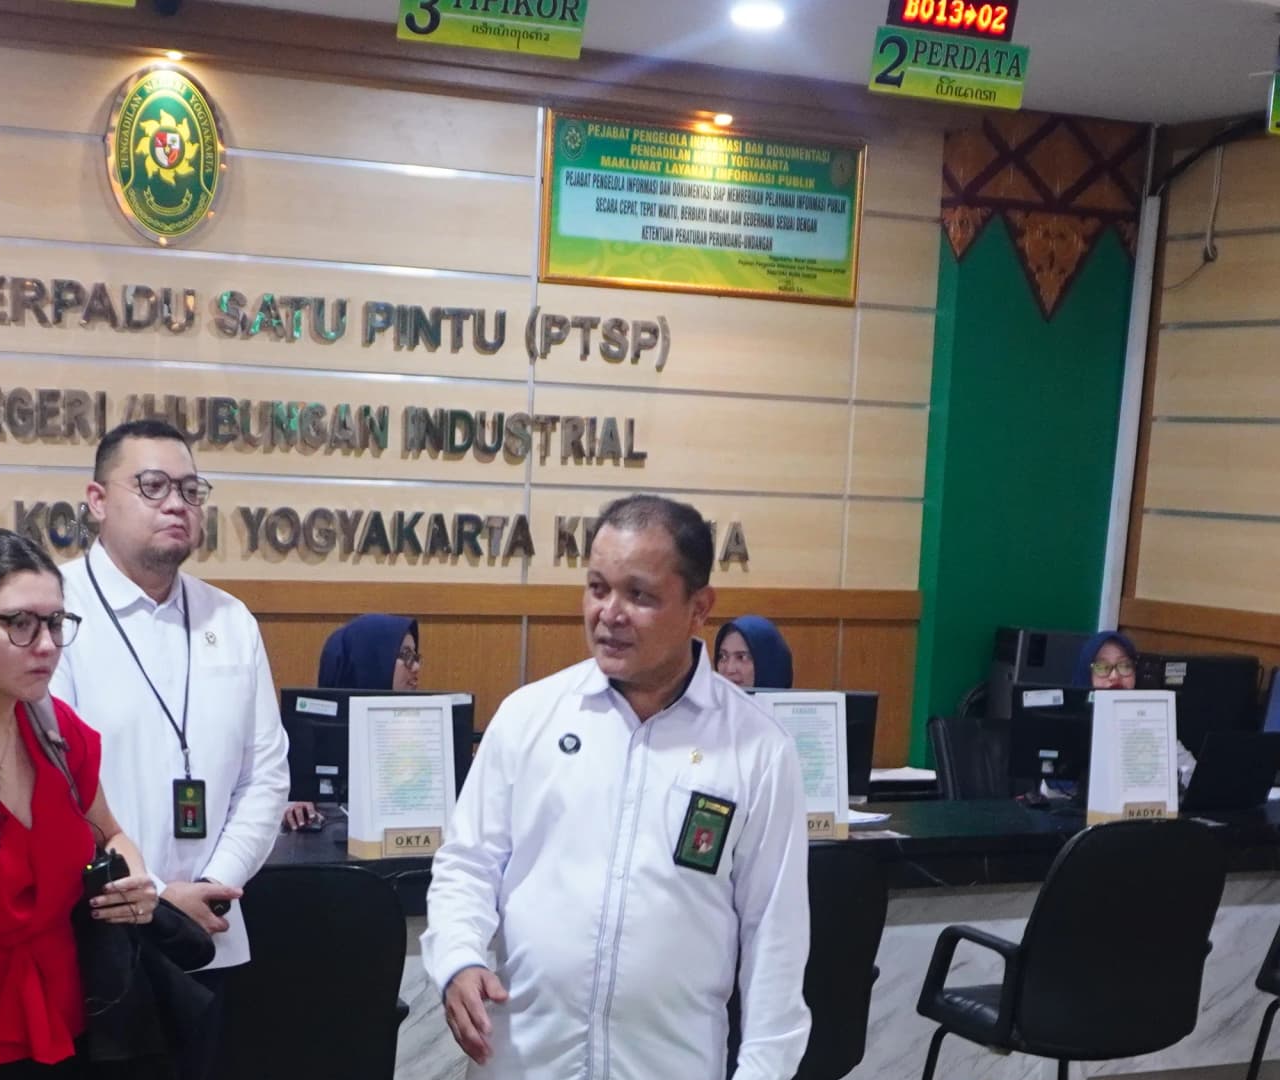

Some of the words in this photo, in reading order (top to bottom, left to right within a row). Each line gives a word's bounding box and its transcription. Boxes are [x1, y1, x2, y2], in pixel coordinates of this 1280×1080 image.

[404, 0, 442, 35] 3
[977, 4, 1009, 34] 02
[874, 35, 909, 88] 2
[911, 39, 1022, 78] PERDATA
[120, 94, 144, 169] PENGADILAN
[189, 93, 215, 173] YOGYAKARTA
[587, 123, 631, 140] PEJABAT
[632, 128, 689, 147] PENGELOLA
[744, 141, 764, 156] DAN
[766, 144, 832, 163] DOKUMENTASI
[600, 155, 662, 173] MAKLUMAT
[665, 161, 713, 180] LAYANAN
[716, 167, 775, 185] INFORMASI
[778, 175, 816, 190] PUBLIK
[630, 143, 691, 162] PENGADILAN
[731, 154, 790, 172] YOGYAKARTA
[565, 170, 591, 187] PEJABAT
[592, 173, 625, 192] PENGELOLA
[626, 178, 659, 195] INFORMASI
[660, 180, 671, 196] DAN
[672, 181, 712, 200] DOKUMENTASI
[712, 185, 726, 201] SIAP
[726, 187, 764, 206] MEMBERIKAN
[765, 191, 796, 209] PELAYANAN
[797, 194, 827, 212] INFORMASI
[827, 197, 848, 215] PUBLIK
[595, 196, 619, 213] SECARA
[640, 201, 657, 217] TEPAT
[680, 205, 708, 222] BERBIAYA
[708, 207, 730, 225] RINGAN
[730, 209, 742, 226] DAN
[742, 211, 776, 230] SEDERHANA
[776, 214, 796, 231] SESUAI
[796, 216, 818, 233] DENGAN
[641, 224, 675, 242] KETENTUAN
[675, 227, 708, 245] PERATURAN
[708, 230, 774, 252] PERUNDANG-UNDANGAN
[220, 290, 347, 342] SATU
[361, 300, 507, 355] PINTU
[524, 306, 671, 371] (PTSP)
[402, 405, 648, 469] INDUSTRIAL
[239, 506, 536, 563] YOGYAKARTA
[1128, 807, 1163, 818] NADYA
[394, 834, 432, 847] OKTA
